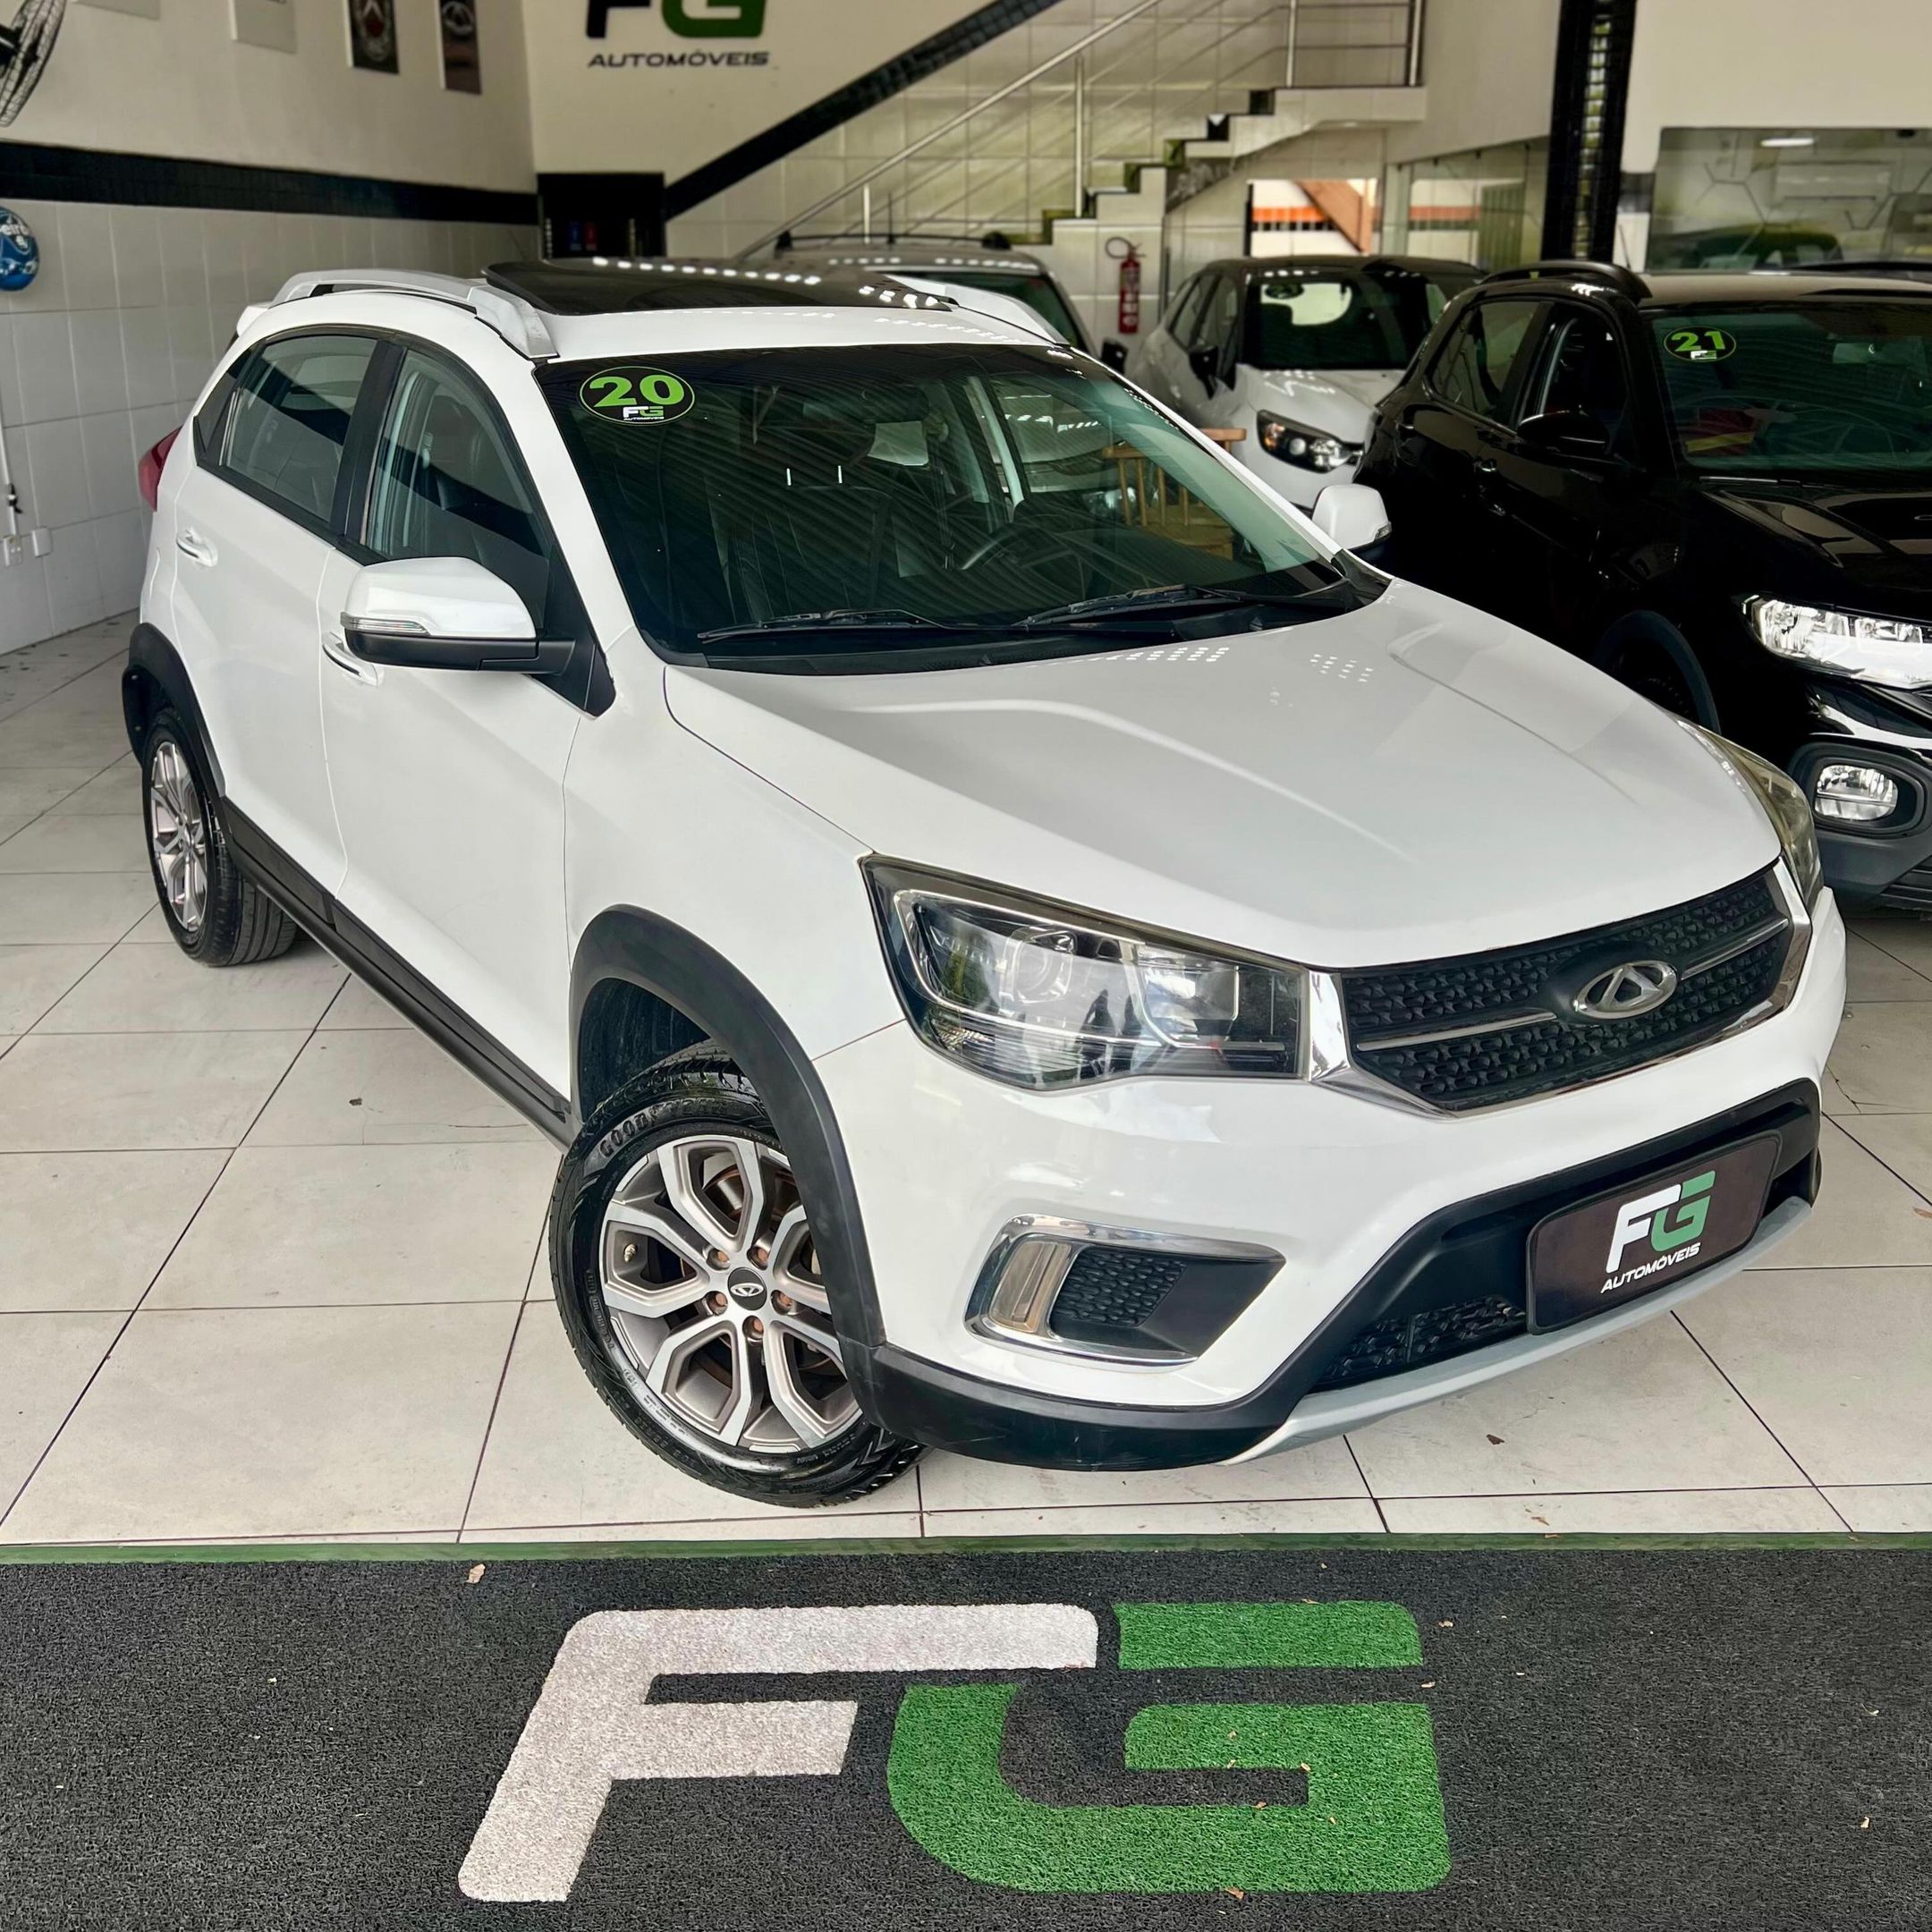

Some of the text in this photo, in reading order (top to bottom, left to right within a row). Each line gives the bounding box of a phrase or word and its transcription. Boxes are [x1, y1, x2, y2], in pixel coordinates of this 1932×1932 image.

[588, 50, 769, 68] AUTOMÓVEIS
[1671, 331, 1725, 352] 21
[589, 375, 685, 408] 20
[623, 406, 664, 418] FG
[1606, 1170, 1716, 1273] FG
[1600, 1241, 1700, 1293] AUTOMÓVEIS
[458, 1601, 1451, 1902] FG
